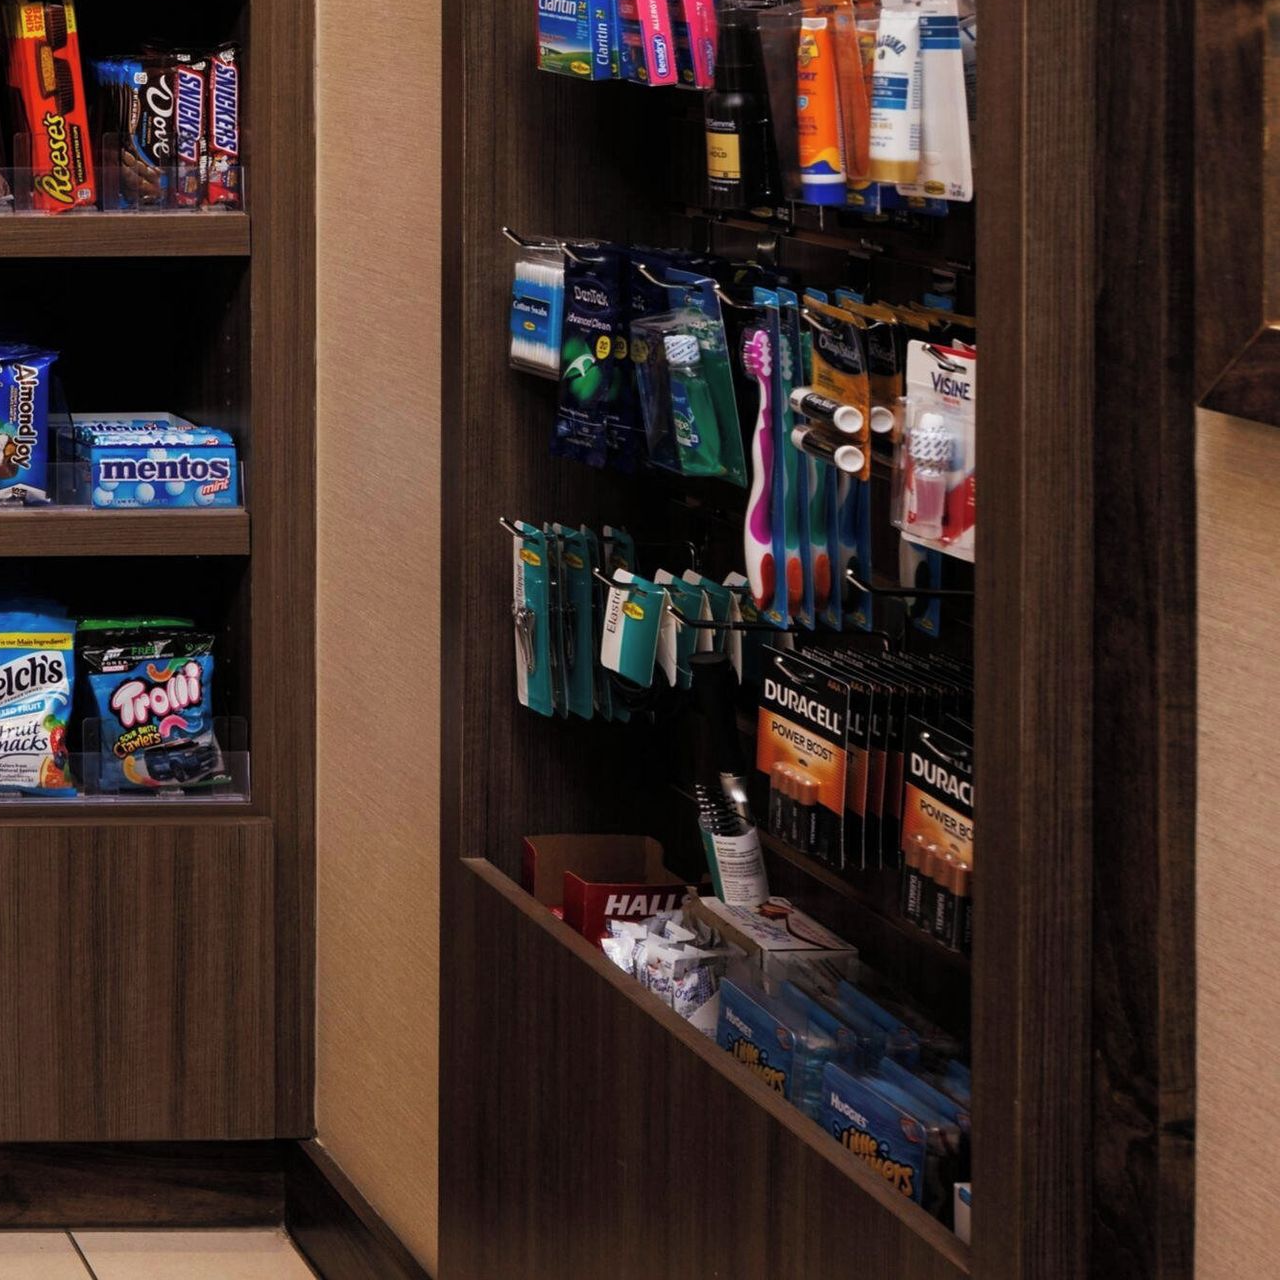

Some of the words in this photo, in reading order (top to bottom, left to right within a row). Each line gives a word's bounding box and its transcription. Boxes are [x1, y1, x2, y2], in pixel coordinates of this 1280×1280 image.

[649, 0, 660, 31] ALLERGY
[596, 22, 609, 66] Claritin
[657, 37, 668, 74] Benadryl
[145, 73, 174, 159] Dove
[176, 67, 205, 162] SNICKERS
[214, 60, 239, 156] SNICKERS
[34, 112, 74, 203] Reese's
[512, 299, 531, 313] Cotton
[530, 303, 548, 317] Swabs
[573, 286, 610, 307] DenTek
[12, 362, 40, 427] Almond
[98, 457, 230, 481] mentos
[200, 478, 230, 496] mint
[17, 702, 42, 714] FRUIT
[112, 662, 201, 728] Trolli
[764, 677, 841, 735] DURACELL
[113, 732, 161, 758] Crawlers
[771, 720, 806, 748] POWER
[806, 739, 833, 762] BOOST
[920, 799, 957, 832] POWER
